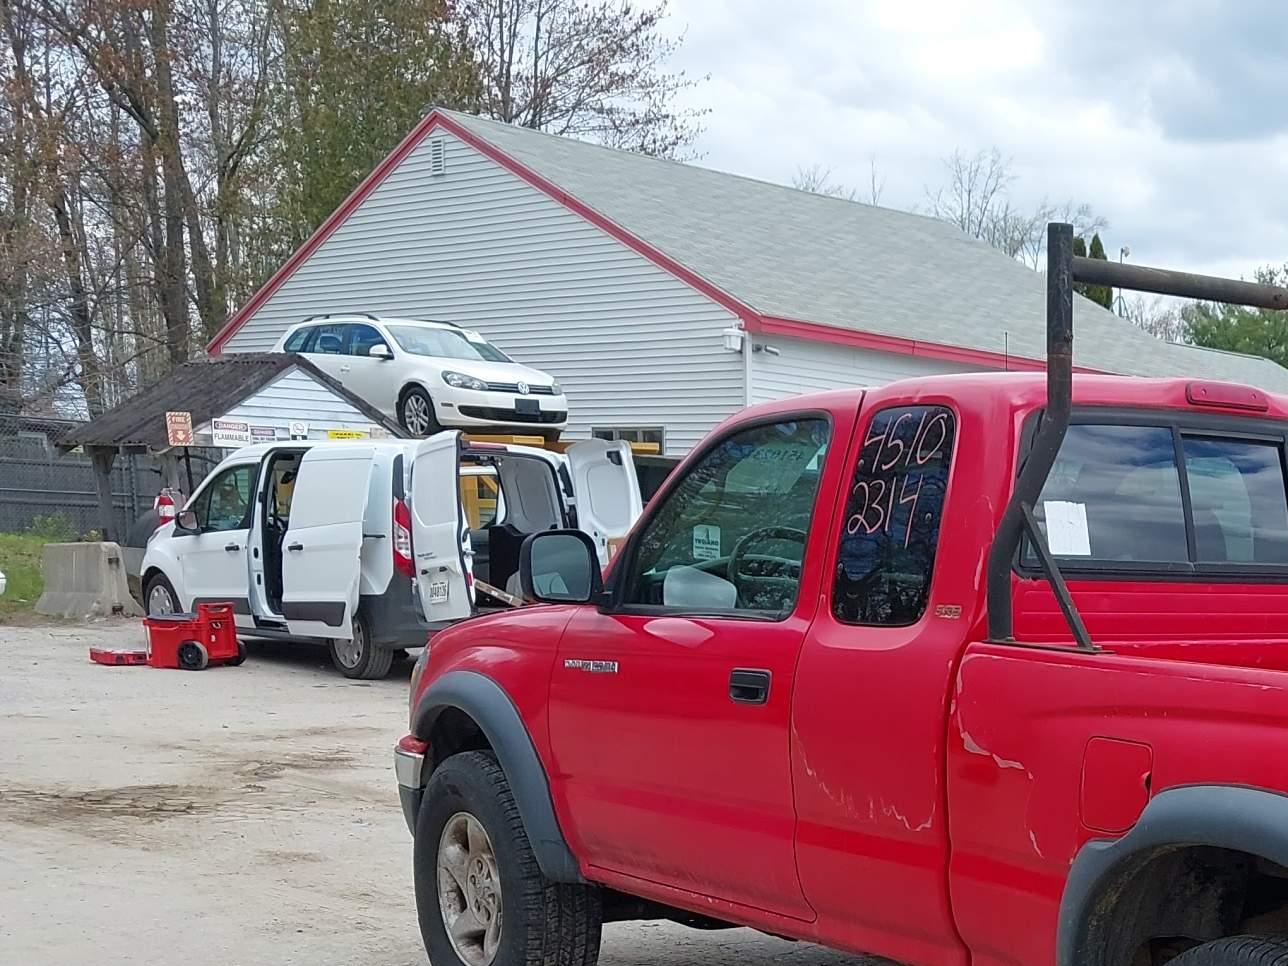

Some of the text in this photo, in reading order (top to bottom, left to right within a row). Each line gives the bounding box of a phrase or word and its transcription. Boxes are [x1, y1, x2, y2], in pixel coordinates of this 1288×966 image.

[214, 432, 249, 441] FLAMMABLE
[864, 410, 948, 473] 4510
[847, 473, 924, 549] 2314
